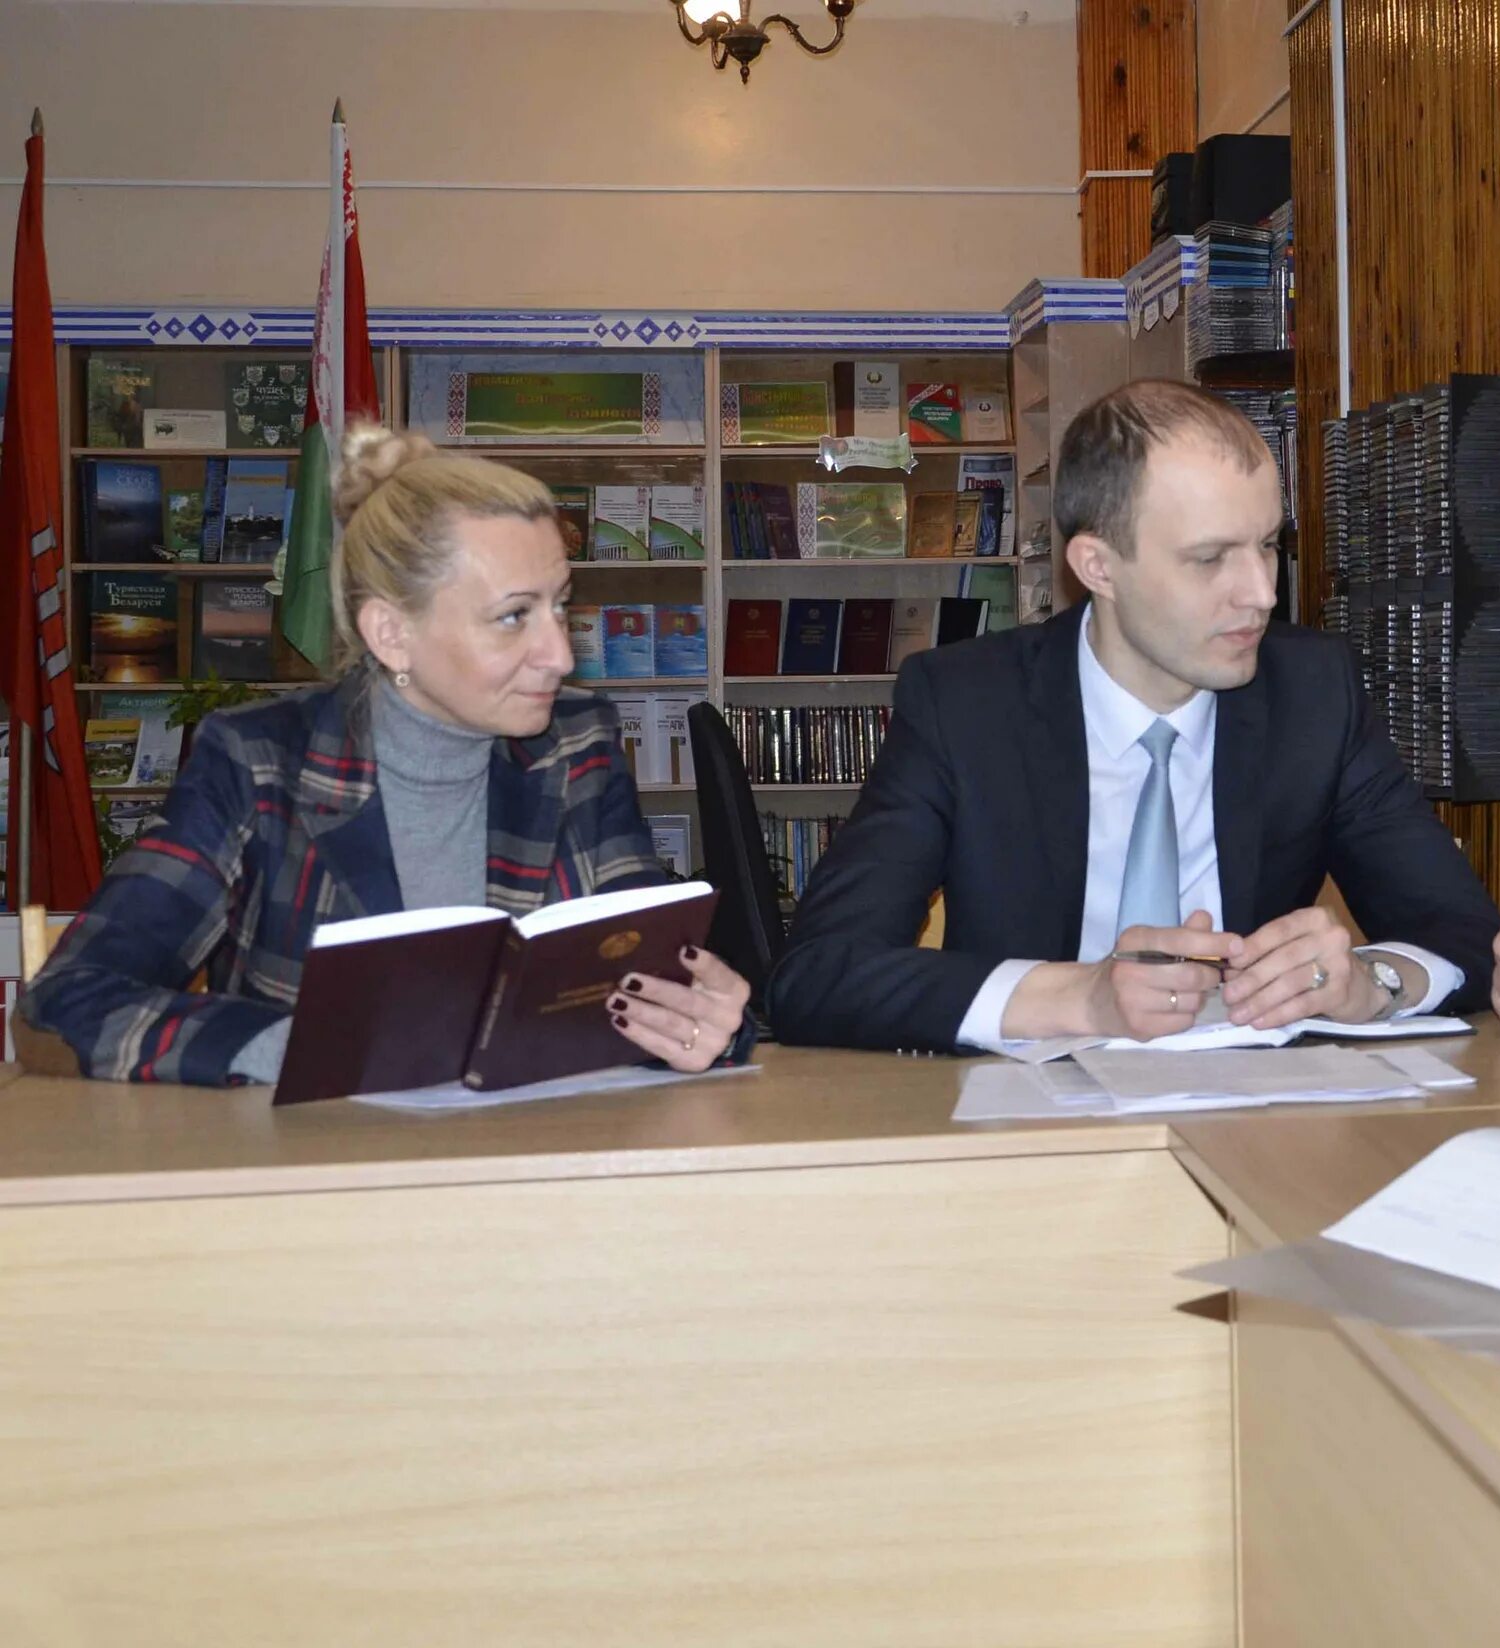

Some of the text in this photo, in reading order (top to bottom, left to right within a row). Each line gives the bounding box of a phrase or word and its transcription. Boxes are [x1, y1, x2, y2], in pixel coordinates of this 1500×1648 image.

[104, 582, 166, 594] Туристская
[110, 594, 162, 608] Беларуси
[623, 720, 642, 732] АПК
[670, 720, 686, 731] АПК
